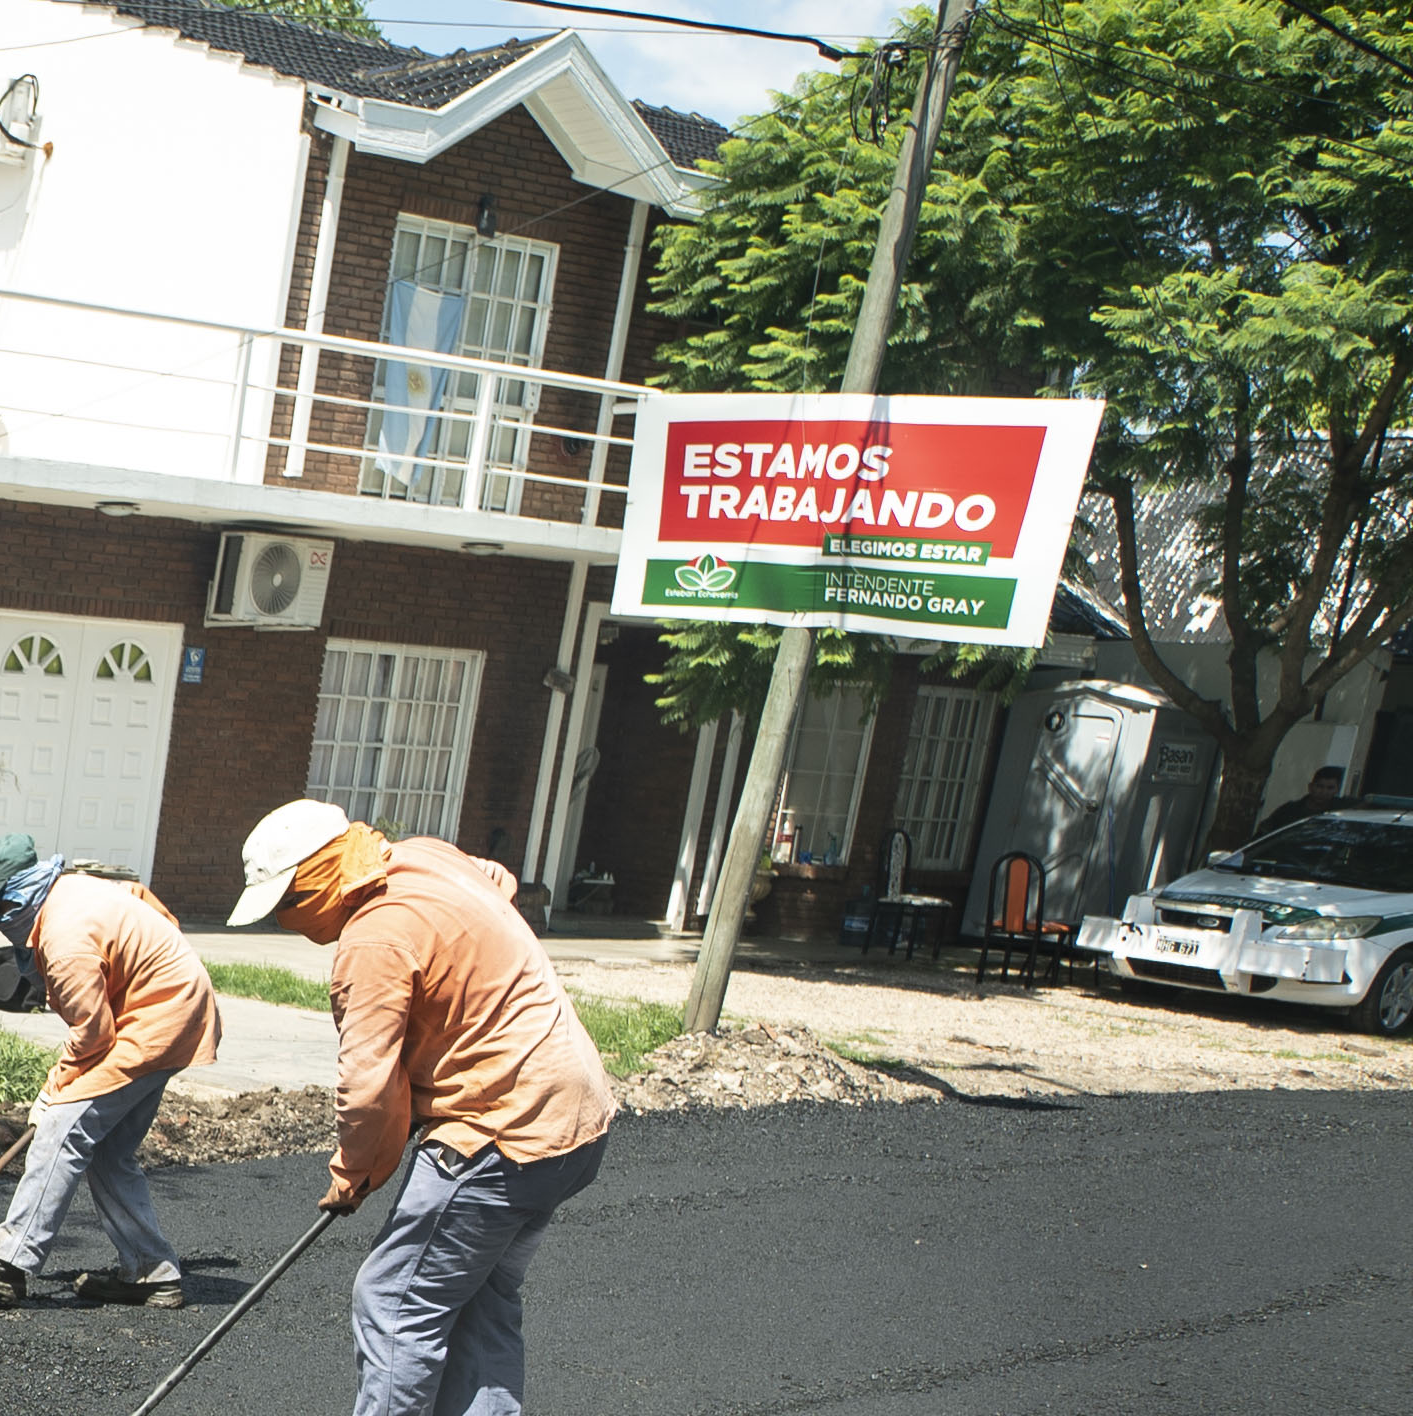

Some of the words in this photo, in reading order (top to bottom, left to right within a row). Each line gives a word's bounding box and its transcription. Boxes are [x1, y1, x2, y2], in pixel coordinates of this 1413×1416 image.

[682, 442, 893, 482] ESTAMOS
[679, 484, 997, 532] TRABAJANDO
[829, 538, 918, 559] ELEGIMOS
[919, 543, 983, 563] ESTAR
[824, 571, 936, 597] INTENDENTE
[824, 587, 923, 612] FERNANDO
[926, 597, 986, 617] GRAY
